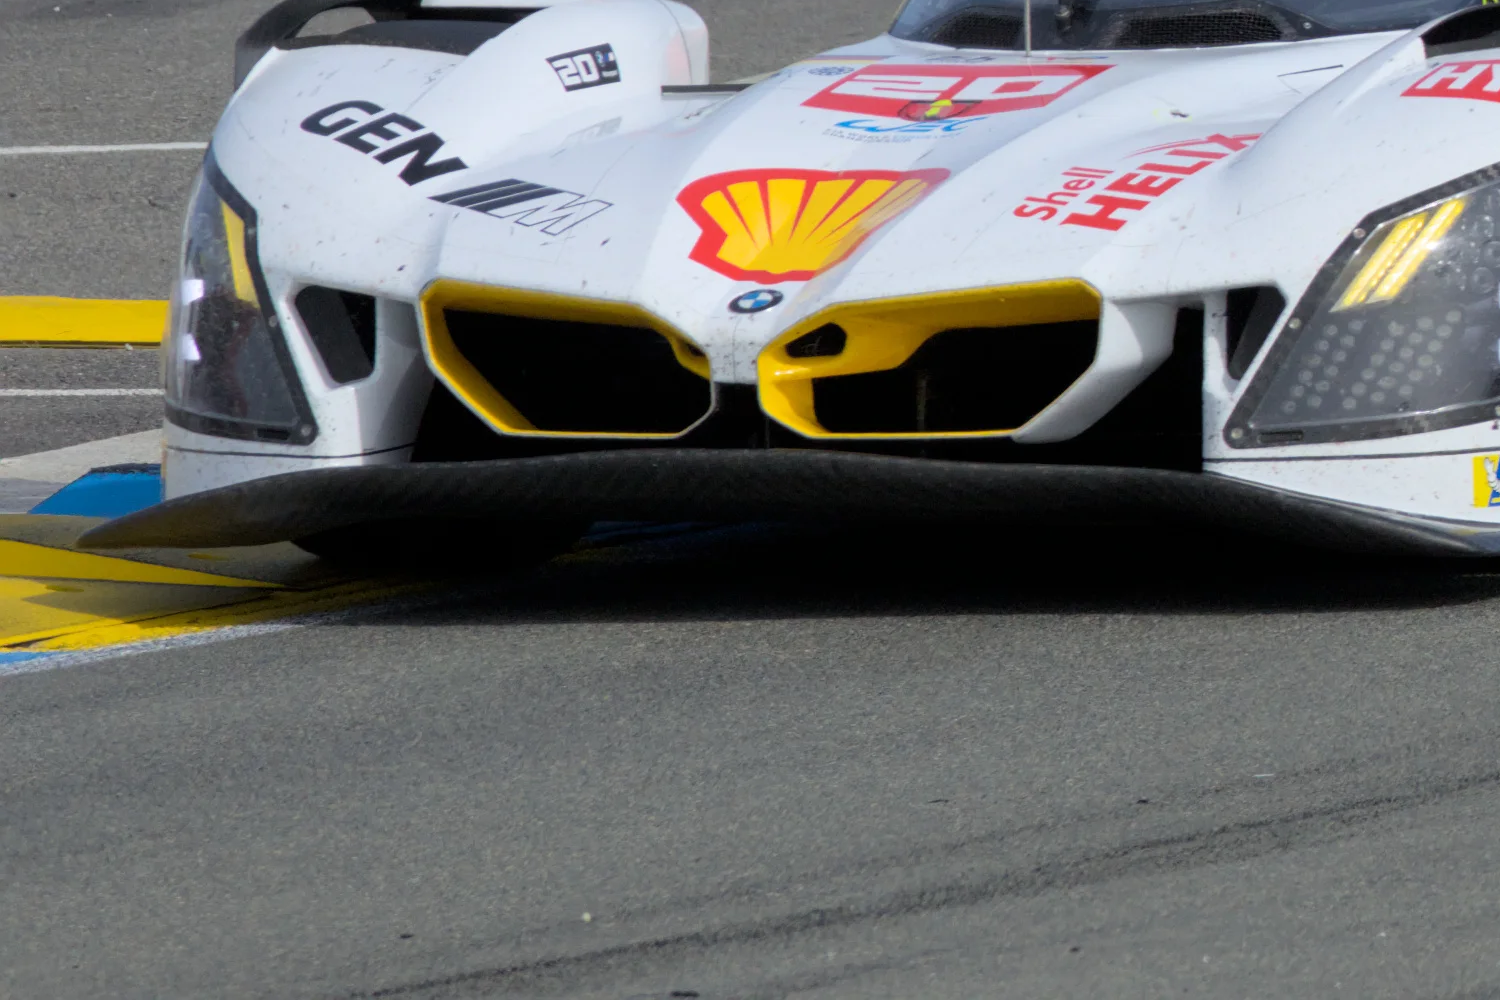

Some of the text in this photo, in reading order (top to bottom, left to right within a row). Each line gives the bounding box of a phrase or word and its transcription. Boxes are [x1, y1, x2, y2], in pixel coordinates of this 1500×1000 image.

[551, 53, 600, 86] 20
[830, 74, 1086, 101] 20
[300, 100, 468, 186] GEN
[1013, 165, 1115, 221] Shell
[1058, 132, 1264, 232] HELIX
